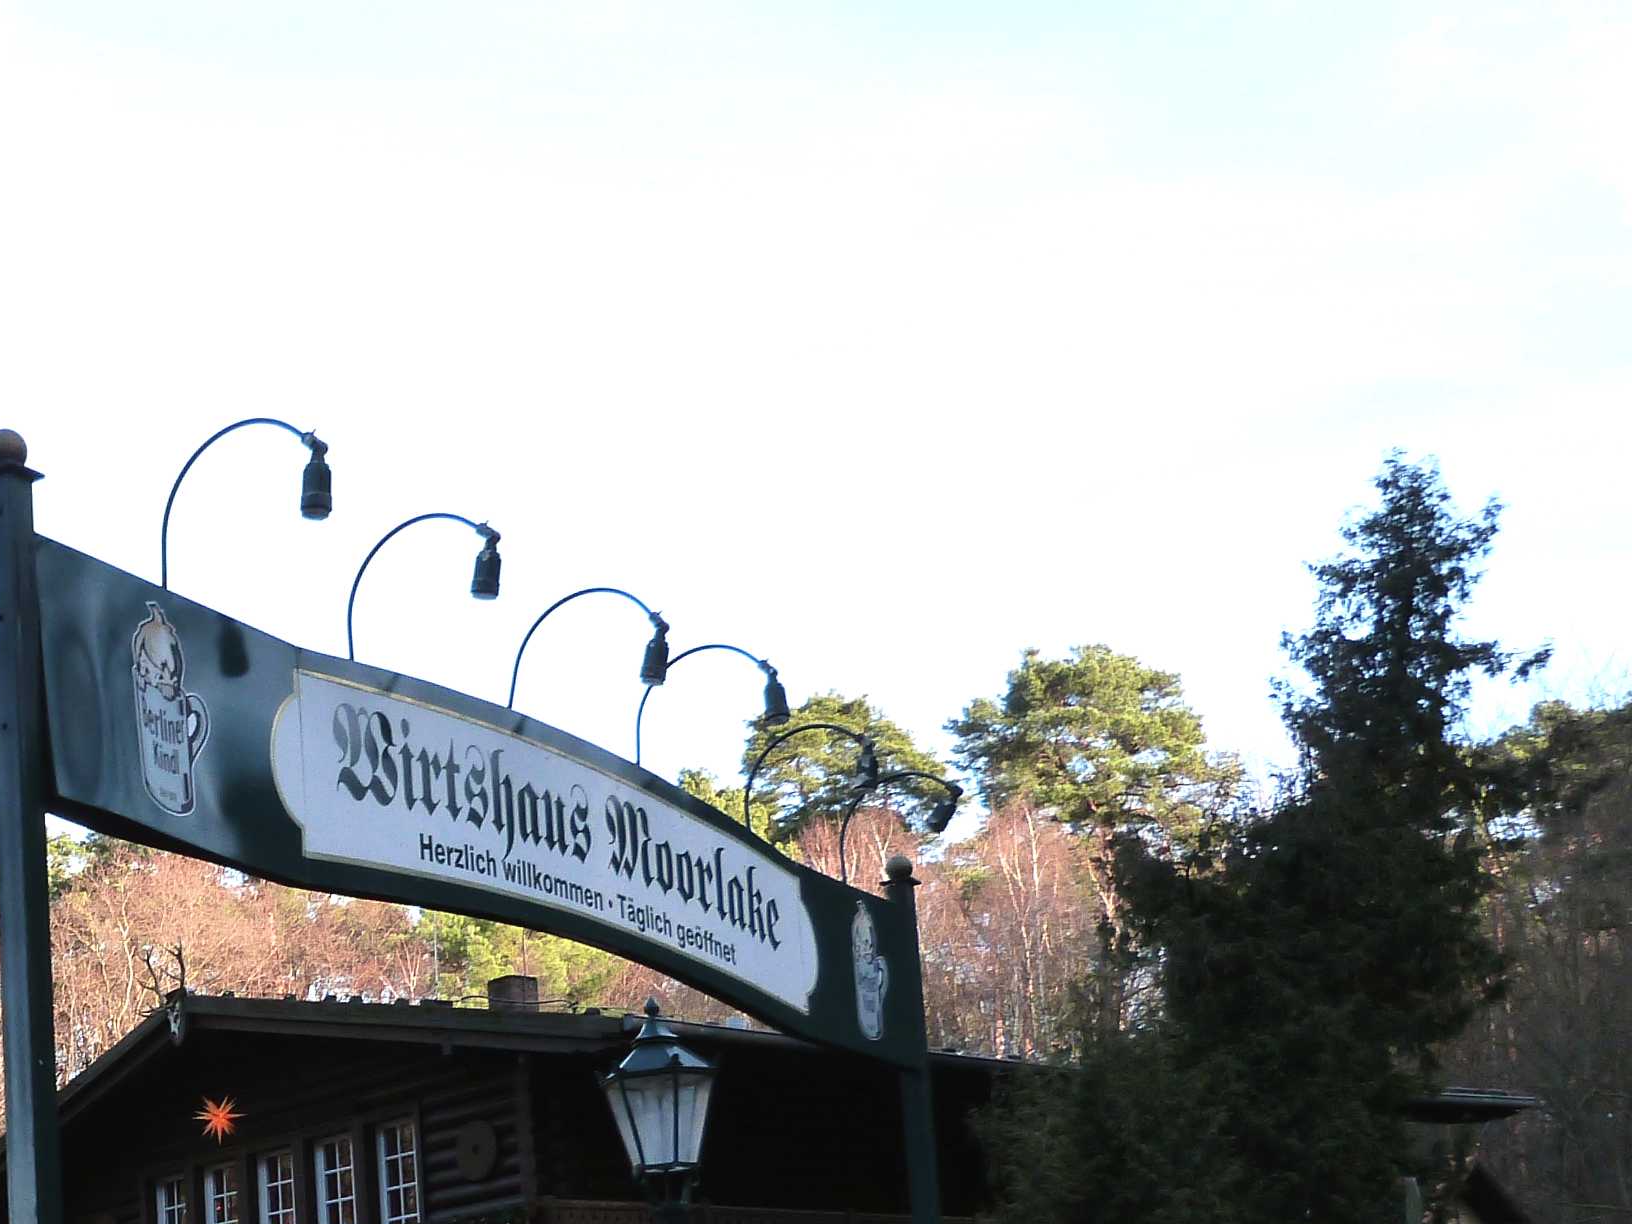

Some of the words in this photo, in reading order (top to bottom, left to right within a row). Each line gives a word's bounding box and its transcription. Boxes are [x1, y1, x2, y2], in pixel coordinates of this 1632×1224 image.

[332, 703, 591, 863] Wirtshaus
[605, 795, 781, 951] Moorlake
[419, 833, 497, 877] Herzlich
[502, 859, 604, 911] willkommen
[616, 893, 672, 934] Täglich
[677, 924, 736, 965] geöffnet
